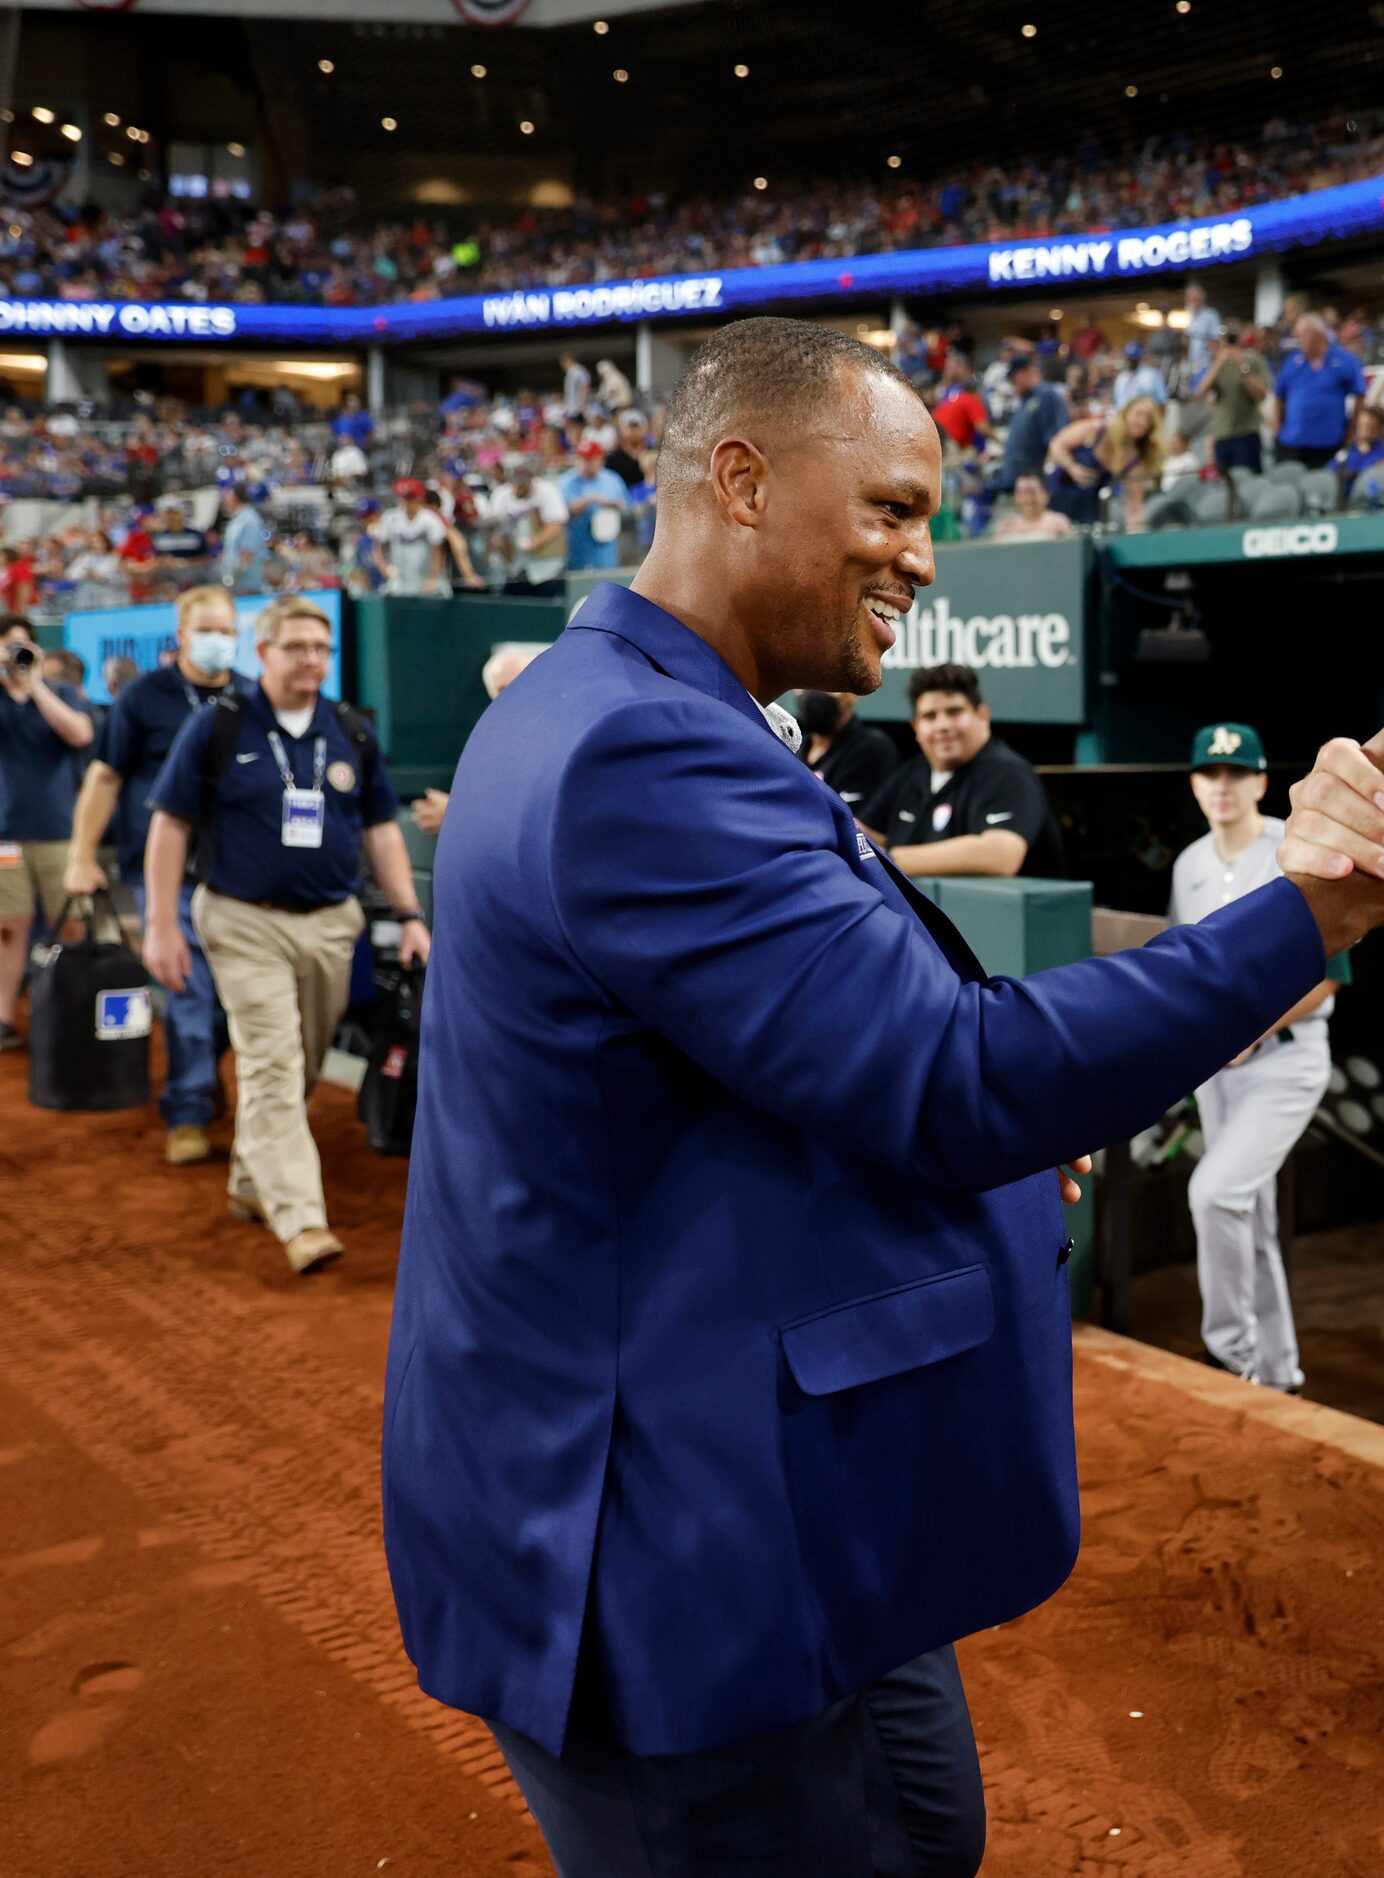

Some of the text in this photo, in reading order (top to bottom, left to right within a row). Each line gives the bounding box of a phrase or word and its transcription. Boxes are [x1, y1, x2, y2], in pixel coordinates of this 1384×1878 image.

[988, 218, 1253, 282] KENNY ROGERS
[118, 304, 236, 336] OATES
[1242, 523, 1338, 558] GEICO
[880, 597, 1071, 669] althcare
